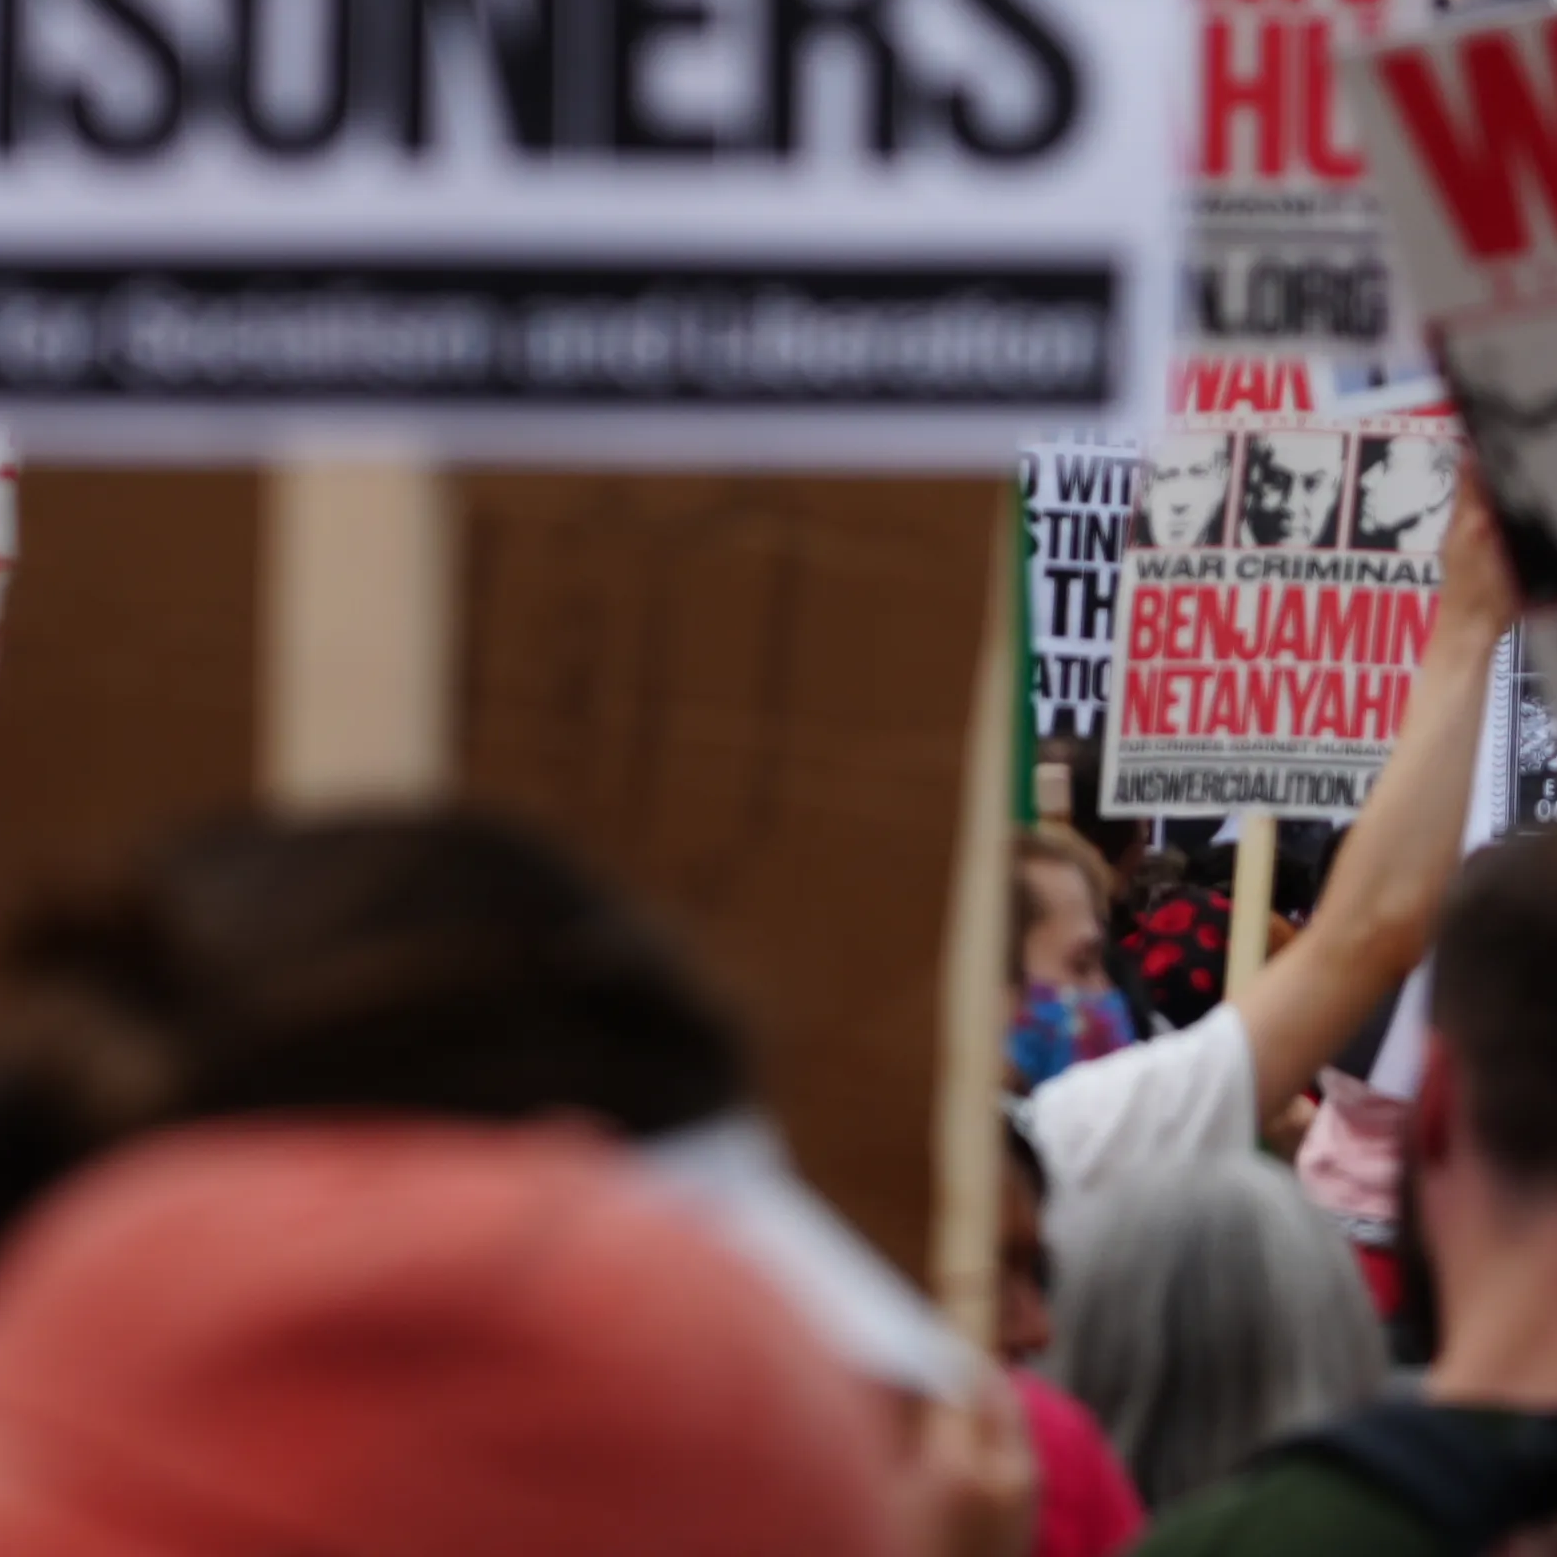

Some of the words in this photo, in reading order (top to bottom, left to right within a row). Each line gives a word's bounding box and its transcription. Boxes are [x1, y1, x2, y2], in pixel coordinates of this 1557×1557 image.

[1135, 555, 1226, 581] WAR
[1235, 555, 1442, 585] CRIMINAL
[1128, 584, 1441, 668] BENJAMIN
